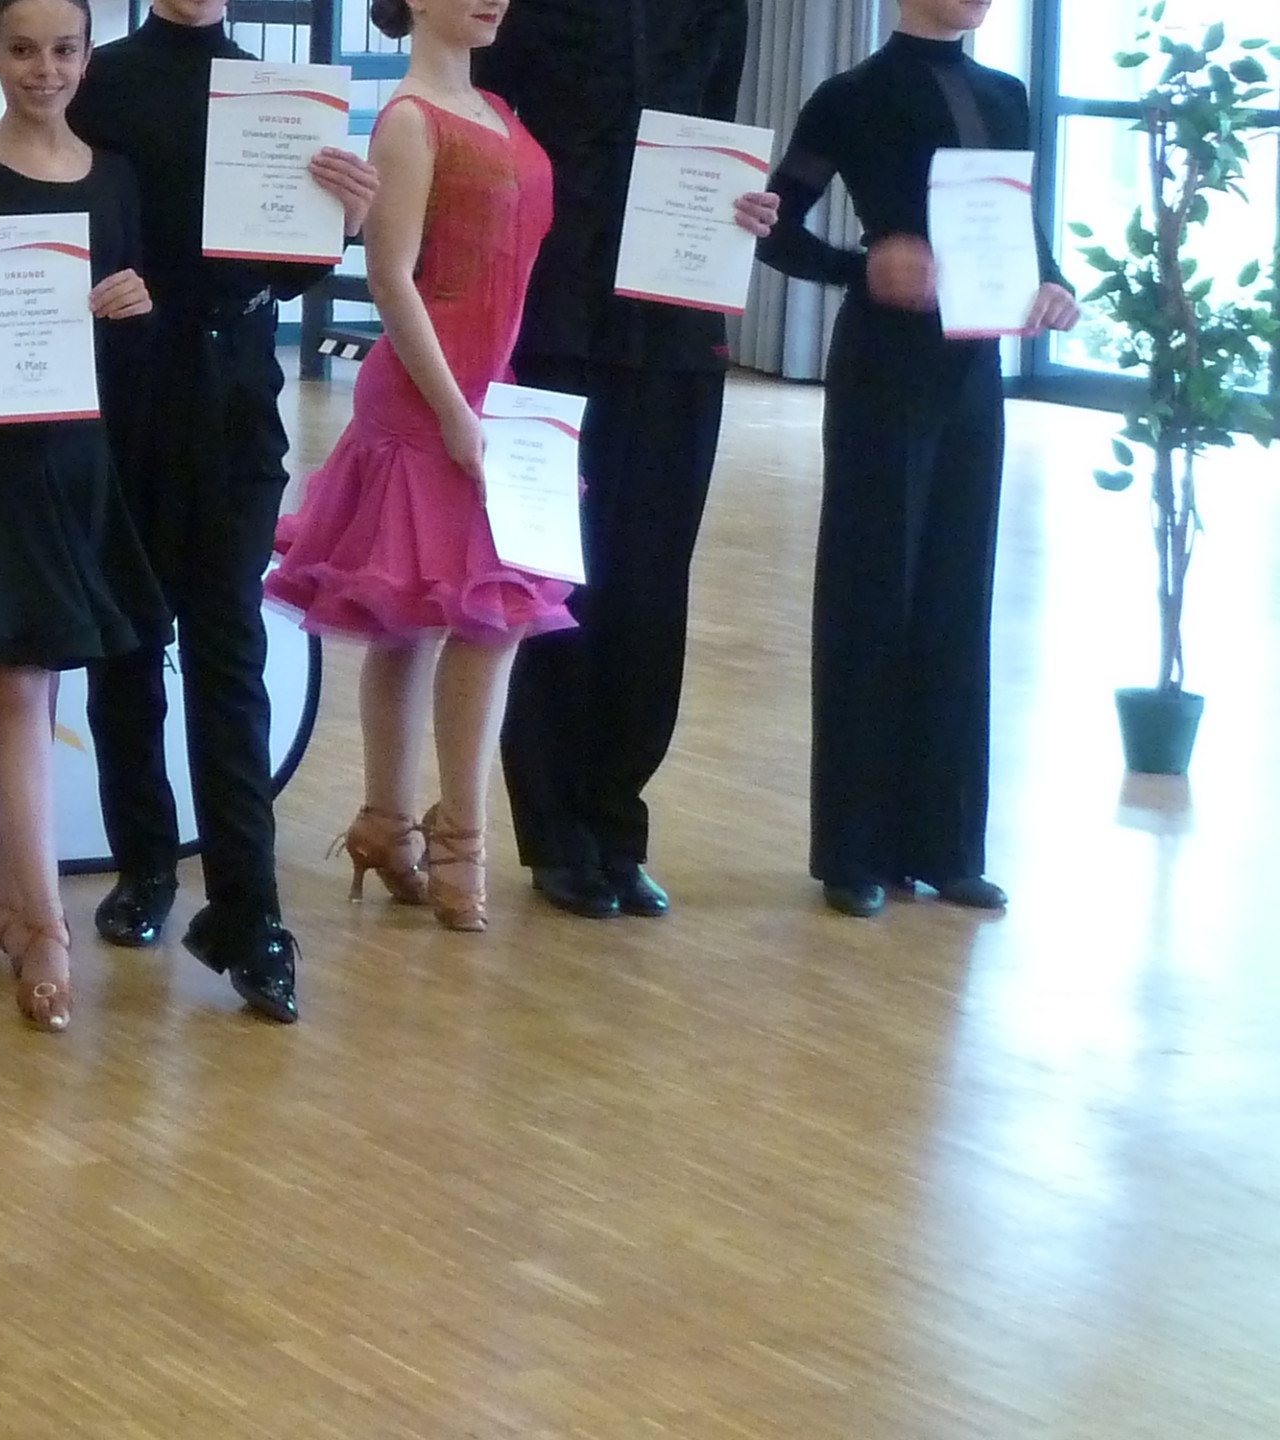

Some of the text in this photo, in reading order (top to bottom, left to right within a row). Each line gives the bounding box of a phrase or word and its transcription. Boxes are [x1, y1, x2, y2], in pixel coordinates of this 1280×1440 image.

[260, 202, 294, 213] 4. Platz
[683, 250, 708, 263] Platz
[25, 361, 48, 371] Platz
